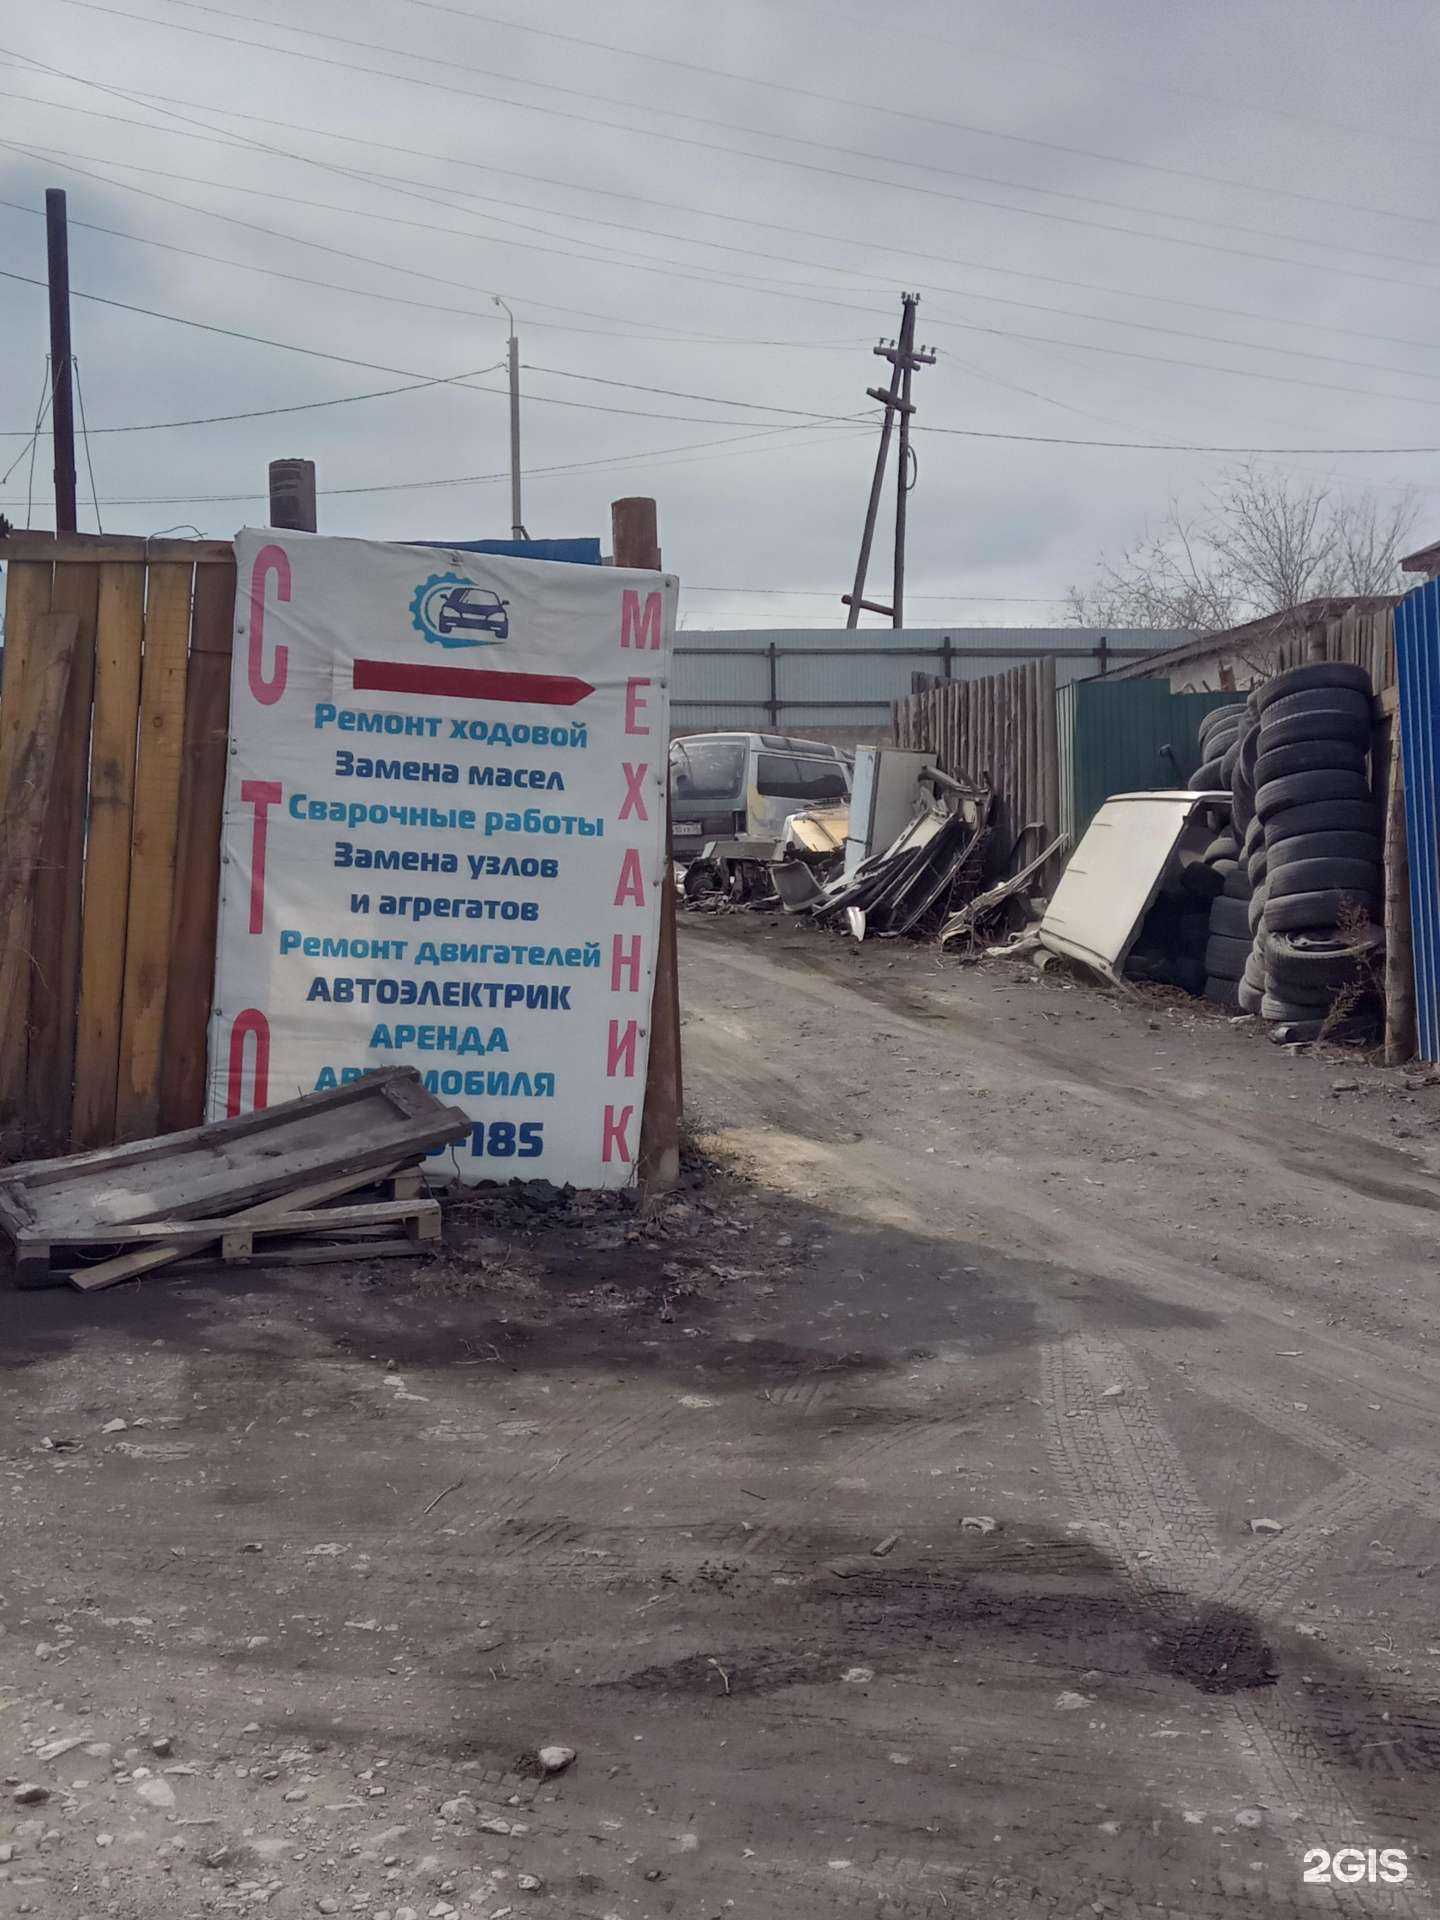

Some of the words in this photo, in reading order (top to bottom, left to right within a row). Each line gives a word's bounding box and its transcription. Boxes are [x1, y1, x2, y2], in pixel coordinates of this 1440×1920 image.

[314, 702, 442, 739] Ремонт
[449, 720, 588, 748] ходовой
[335, 750, 460, 784] Замена
[469, 765, 566, 791] масел
[288, 793, 475, 830] Сварочные
[484, 810, 605, 837] работы
[334, 842, 459, 874] Замена
[468, 854, 560, 880] узлов
[601, 588, 663, 1163] МЕХАНИК
[350, 894, 371, 915] и
[379, 894, 540, 922] агрегатов
[279, 929, 408, 961] Ремонт
[414, 941, 602, 968] двигателей
[306, 976, 572, 1011] АВТОЭЛЕКТРИК
[369, 1023, 510, 1056] АРЕНДА
[314, 1066, 556, 1098] АВМОБИЛЯ
